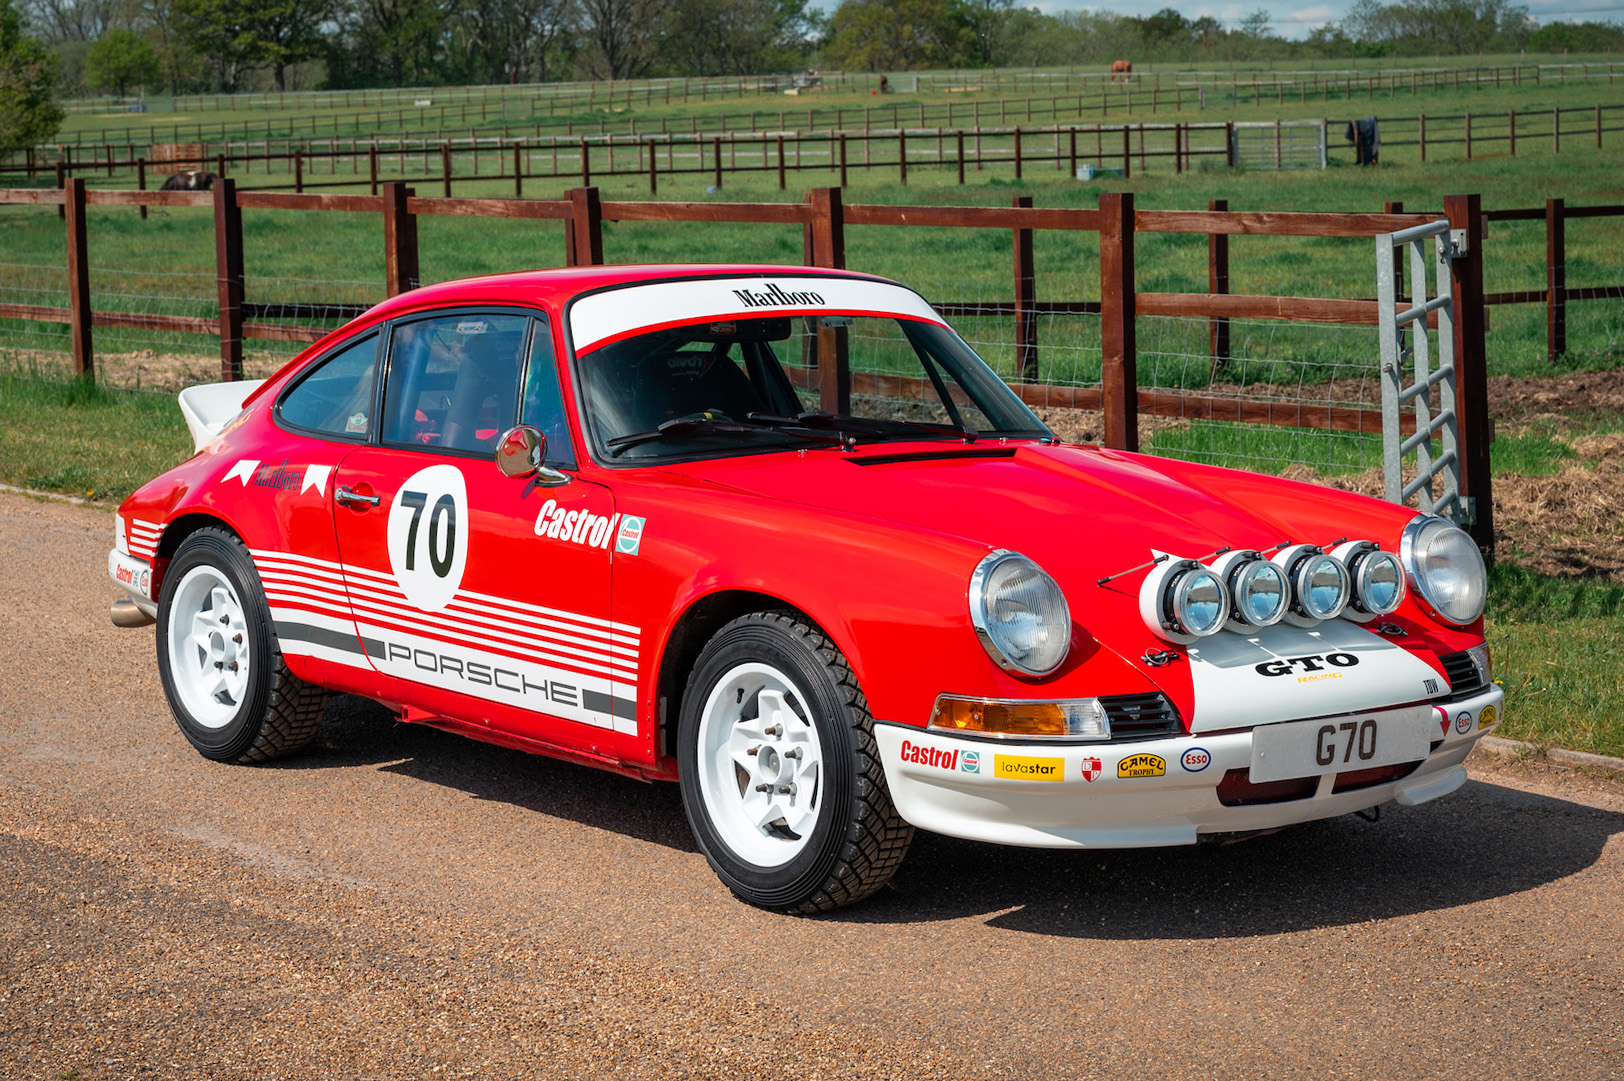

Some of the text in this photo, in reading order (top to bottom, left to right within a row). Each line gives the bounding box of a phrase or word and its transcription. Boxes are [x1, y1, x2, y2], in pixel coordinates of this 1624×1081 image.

[731, 283, 825, 307] Marlboro
[251, 459, 300, 491] Marlboro
[400, 490, 456, 578] 70
[534, 499, 621, 549] Castrol
[622, 529, 639, 539] Castrol
[117, 564, 133, 584] Castrol
[389, 642, 578, 707] PORSCHE
[1255, 653, 1359, 677] GTO
[1297, 671, 1343, 684] RACING
[1423, 678, 1439, 695] TOW
[1315, 719, 1377, 766] G70
[900, 740, 959, 770] Castrol
[1120, 756, 1164, 771] CAMEL
[1002, 761, 1056, 774] lavastar
[1128, 768, 1155, 776] TROPHY
